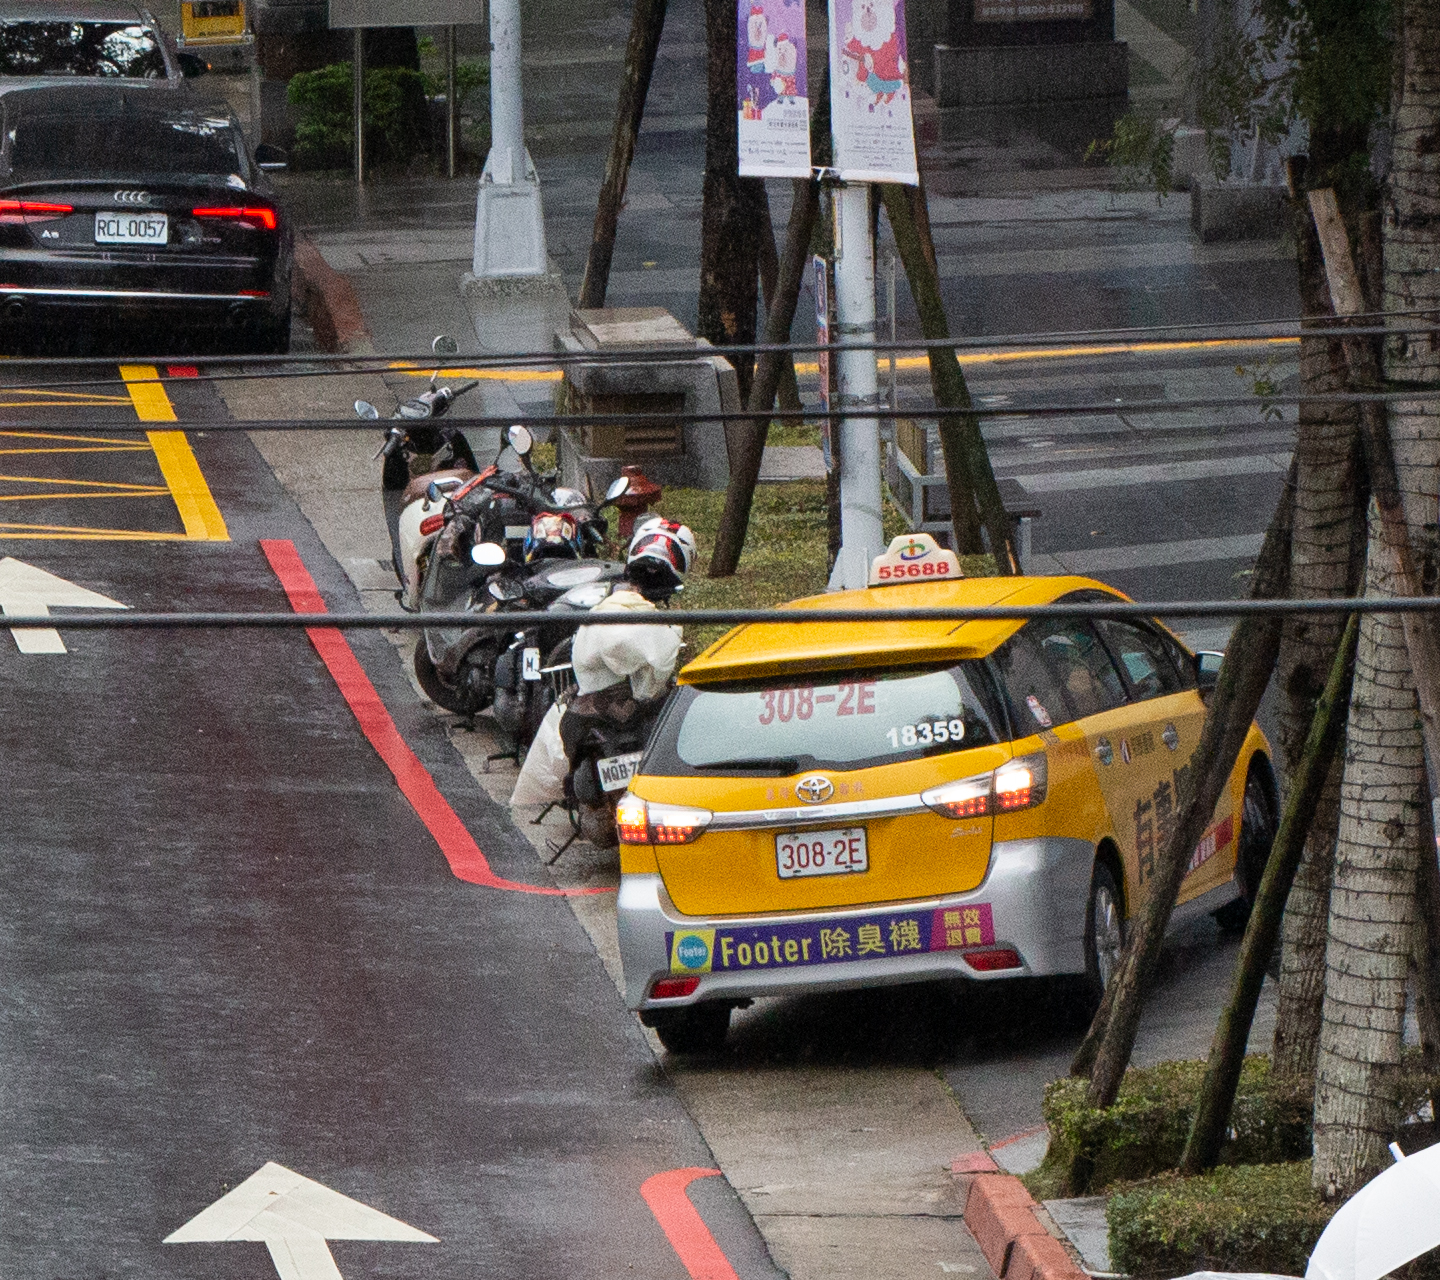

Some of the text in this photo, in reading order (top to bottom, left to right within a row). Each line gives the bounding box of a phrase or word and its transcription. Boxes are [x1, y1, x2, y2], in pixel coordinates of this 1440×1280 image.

[97, 219, 166, 239] RCL-0057
[878, 561, 949, 579] 55688
[758, 680, 877, 725] 308-2E
[886, 719, 965, 748] 18359
[781, 838, 863, 870] 308-2E
[943, 908, 980, 928] 無效
[720, 919, 922, 968] Footer 除臭襪
